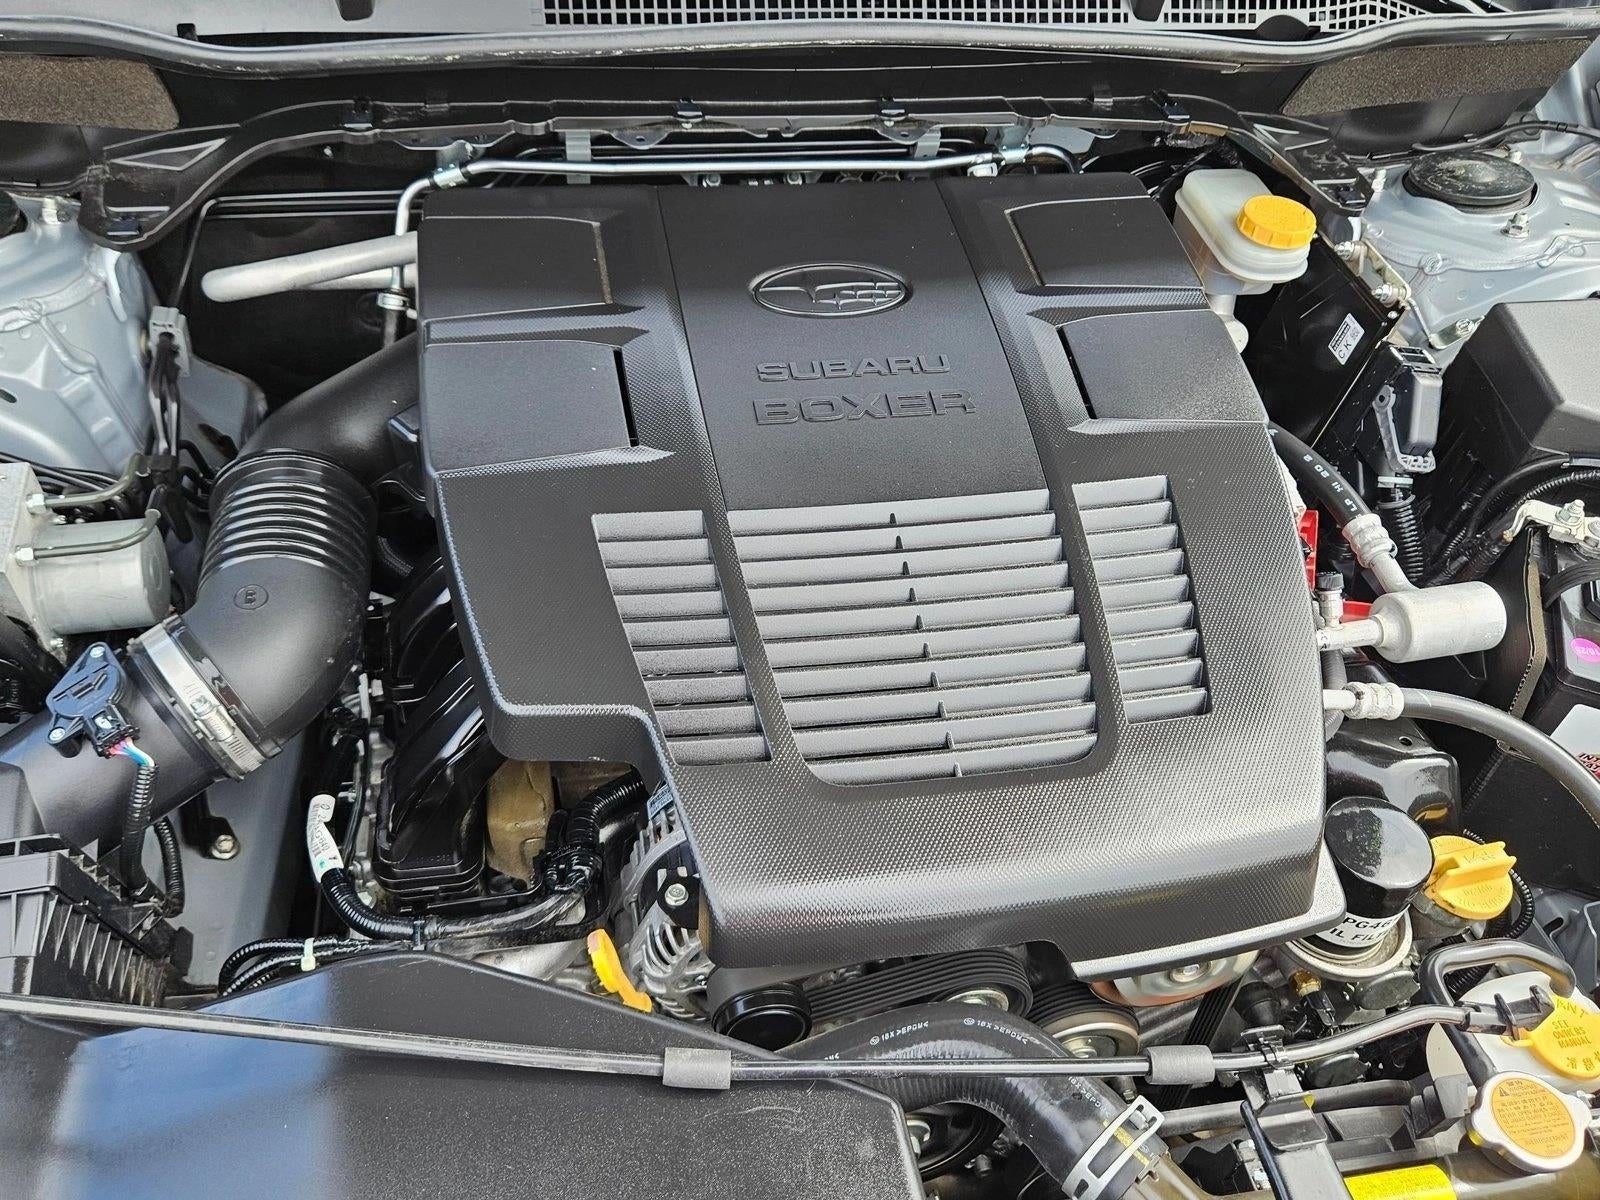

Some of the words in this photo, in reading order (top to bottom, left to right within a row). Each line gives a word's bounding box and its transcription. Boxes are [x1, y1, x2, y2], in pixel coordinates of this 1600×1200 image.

[756, 353, 950, 382] SUBARU
[752, 390, 977, 425] BOXER
[1330, 928, 1345, 938] IL
